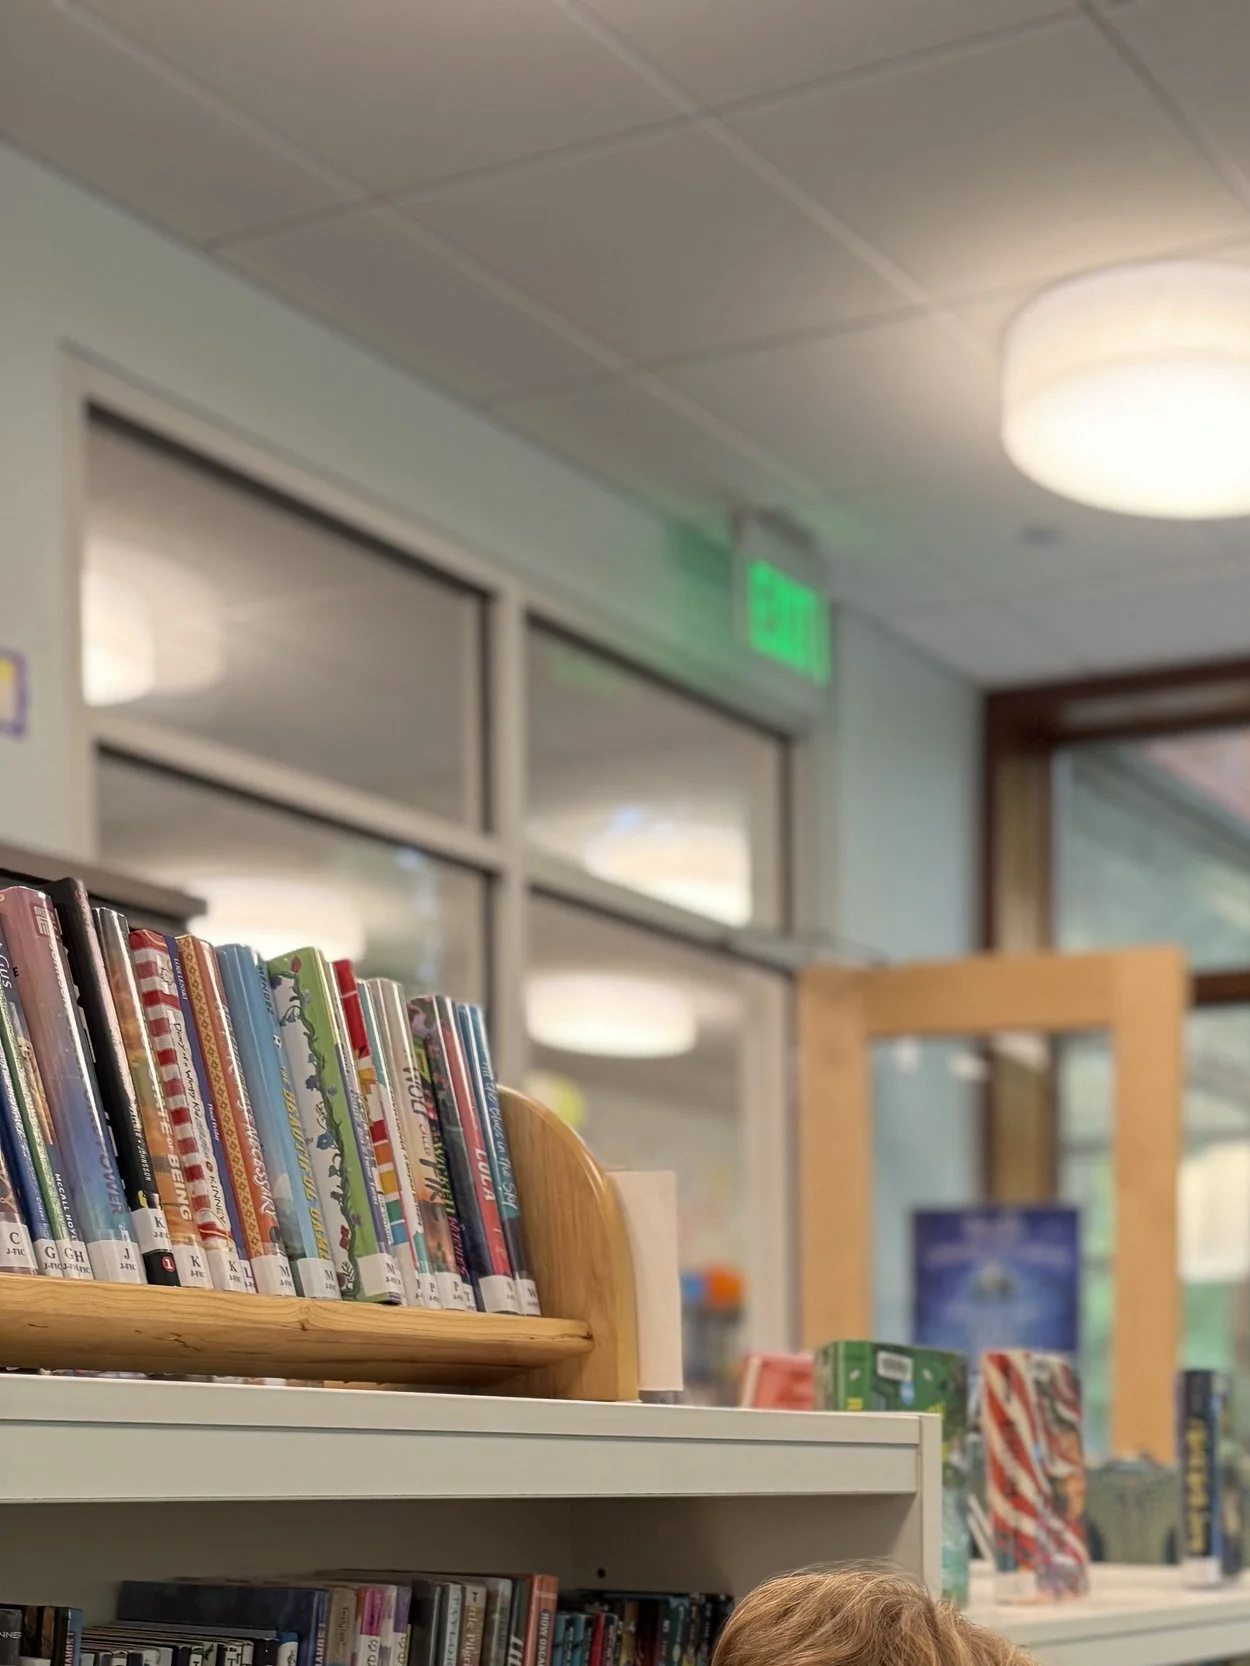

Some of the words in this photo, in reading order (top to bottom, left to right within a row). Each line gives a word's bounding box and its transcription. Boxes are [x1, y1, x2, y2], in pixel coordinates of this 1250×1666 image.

[173, 1021, 185, 1051] Diary
[184, 1069, 197, 1102] Wimpy
[191, 1100, 202, 1118] Kid
[282, 1085, 318, 1203] BEAUTIFUL
[401, 1063, 428, 1120] WOLF
[419, 1155, 450, 1221] FIRE
[95, 1139, 123, 1216] POWER
[243, 1121, 277, 1222] NECESSARY
[166, 1151, 192, 1222] BEING
[497, 1179, 517, 1211] Sky
[208, 1174, 226, 1227] KINNEY
[155, 1216, 164, 1228] K
[10, 1231, 20, 1245] C
[44, 1246, 56, 1259] G
[74, 1249, 84, 1263] H
[124, 1248, 131, 1260] J
[190, 1255, 200, 1268] K
[229, 1260, 237, 1271] K
[280, 1265, 290, 1276] M
[324, 1268, 334, 1281] M
[539, 1612, 550, 1637] HOW
